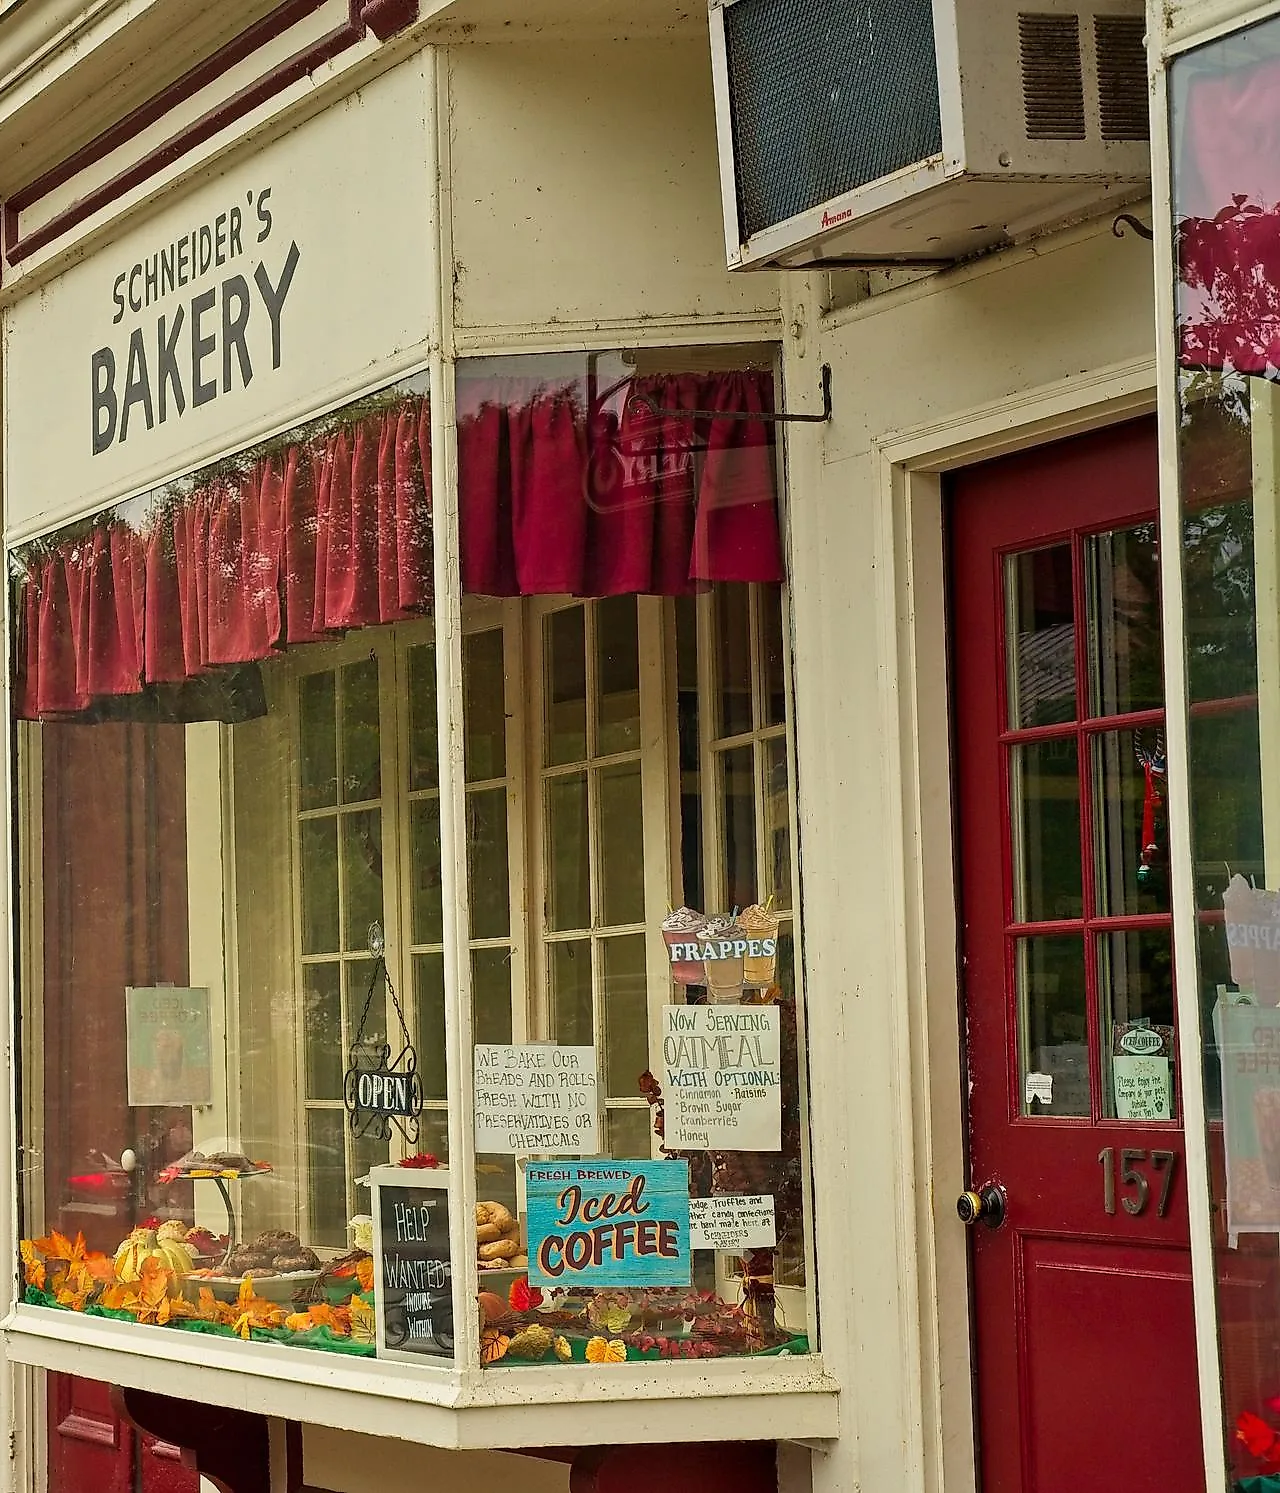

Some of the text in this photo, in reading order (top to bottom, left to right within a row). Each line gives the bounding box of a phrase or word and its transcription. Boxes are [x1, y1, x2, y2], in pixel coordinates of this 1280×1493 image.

[821, 209, 852, 228] Amana
[112, 186, 272, 325] SCHNEIDER'S
[91, 239, 301, 456] BAKERY
[670, 939, 777, 963] FRAPPES
[669, 1008, 771, 1032] NOW SERVING
[476, 1048, 579, 1069] WE BAKE OUR
[664, 1035, 774, 1069] OATMEAL
[528, 1072, 555, 1087] AND
[558, 1072, 595, 1088] ROLLS
[667, 1070, 708, 1088] WITH
[359, 1073, 407, 1112] OPEN
[476, 1089, 587, 1108] FRESH WITH NO
[679, 1087, 767, 1100] Cinnamon Raisins
[679, 1101, 742, 1116] Brown Sugar
[476, 1112, 592, 1130] PRESERVATIVES OR
[680, 1114, 739, 1127] Cranberries
[508, 1133, 580, 1148] CHEMICALS
[679, 1129, 710, 1147] Honey
[529, 1169, 632, 1181] FRESH BREWED
[1097, 1147, 1175, 1217] 157
[555, 1175, 651, 1227] Iced
[713, 1197, 746, 1208] Truffles
[749, 1197, 763, 1205] and
[394, 1202, 429, 1242] HELP
[689, 1212, 706, 1220] ther
[711, 1211, 734, 1221] candy
[538, 1220, 680, 1277] COFFEE
[384, 1253, 445, 1289] WANTED
